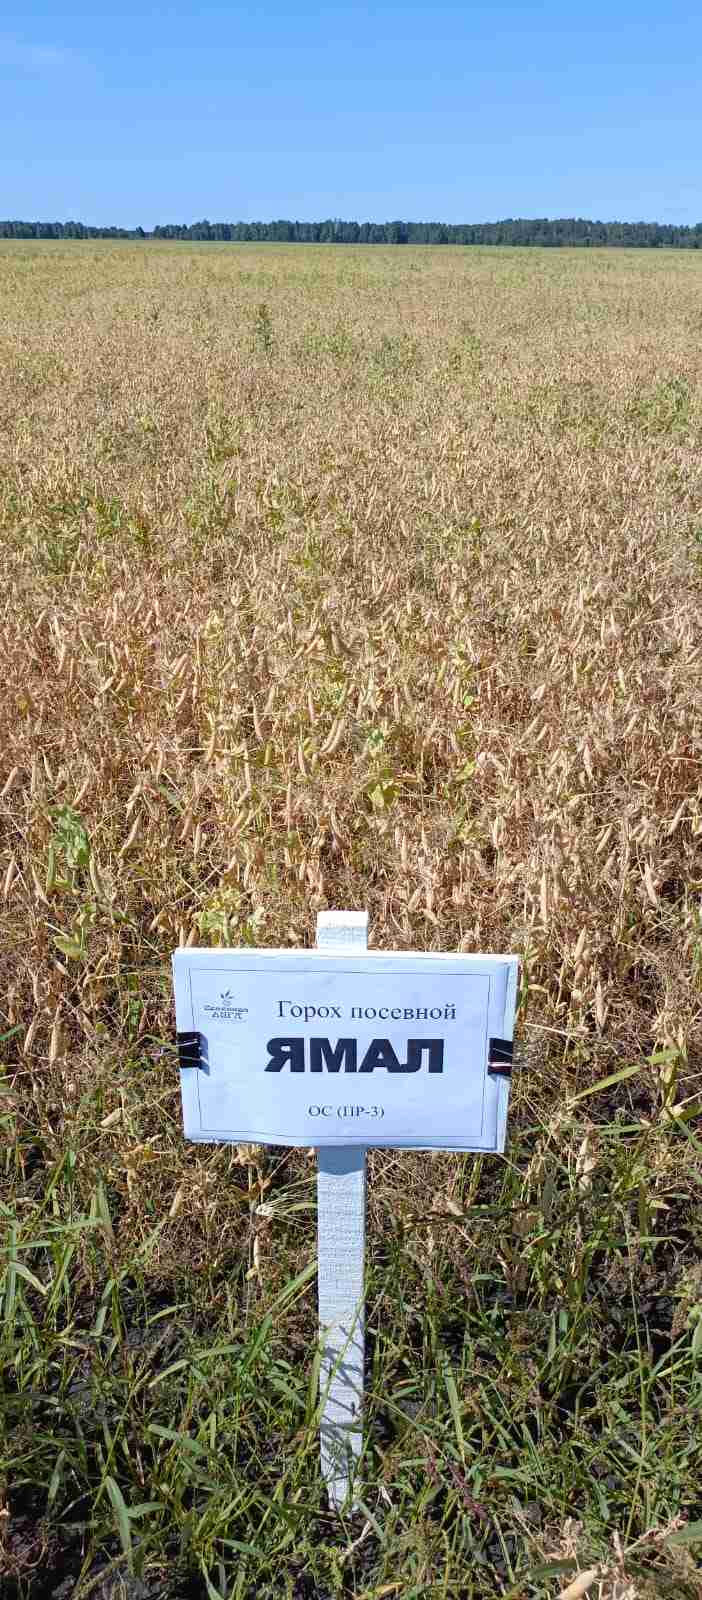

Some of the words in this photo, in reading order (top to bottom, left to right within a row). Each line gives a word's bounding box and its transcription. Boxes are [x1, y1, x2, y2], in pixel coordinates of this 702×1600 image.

[277, 1000, 342, 1023] Горох
[351, 1003, 457, 1020] посевной
[264, 1037, 445, 1074] ЯМАЛ
[336, 1105, 386, 1120] (ПР-3)
